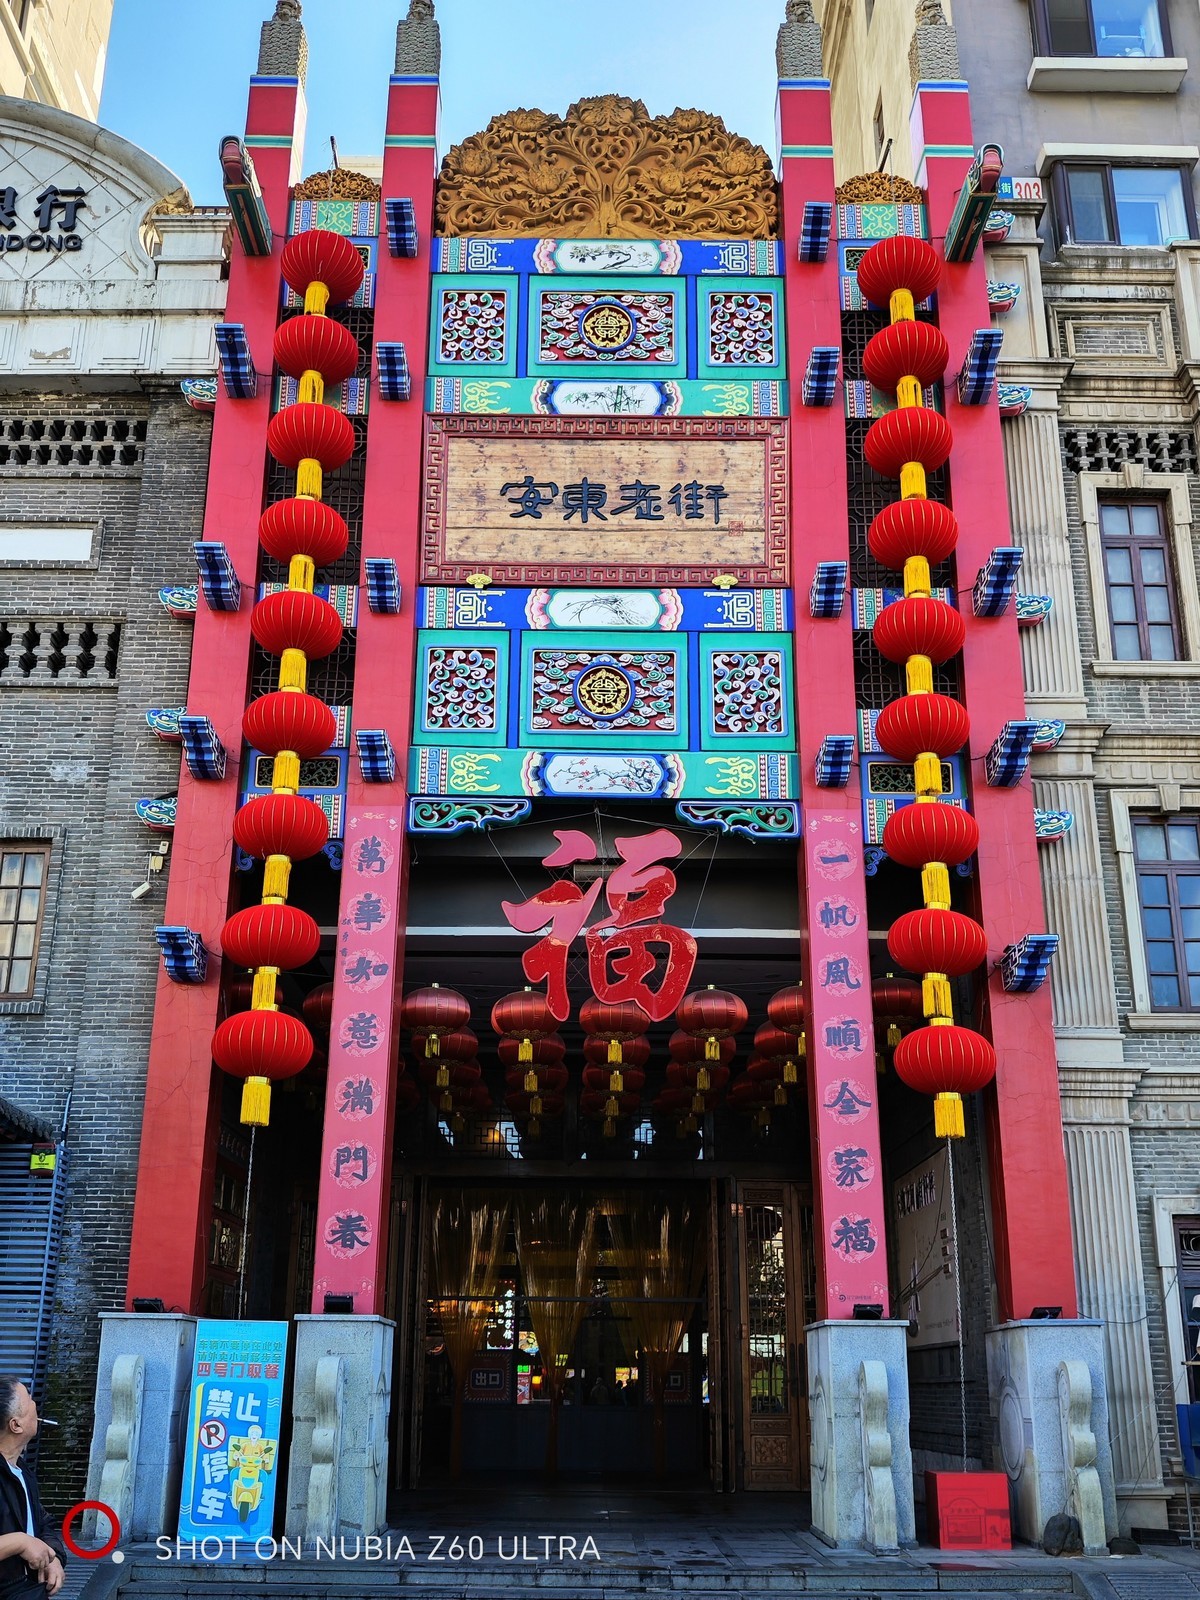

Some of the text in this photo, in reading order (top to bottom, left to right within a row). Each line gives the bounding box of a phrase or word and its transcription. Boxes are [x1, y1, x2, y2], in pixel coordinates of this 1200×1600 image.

[0, 234, 82, 252] DONG
[500, 476, 729, 524] 安東老街
[501, 828, 698, 1022] 福
[199, 1339, 283, 1352] 车辆不要停在此处
[198, 1351, 282, 1363] 请外卖小哥移步至
[197, 1362, 280, 1379] 四号门取餐
[475, 1373, 500, 1386] 出口
[205, 1388, 261, 1423] 禁止
